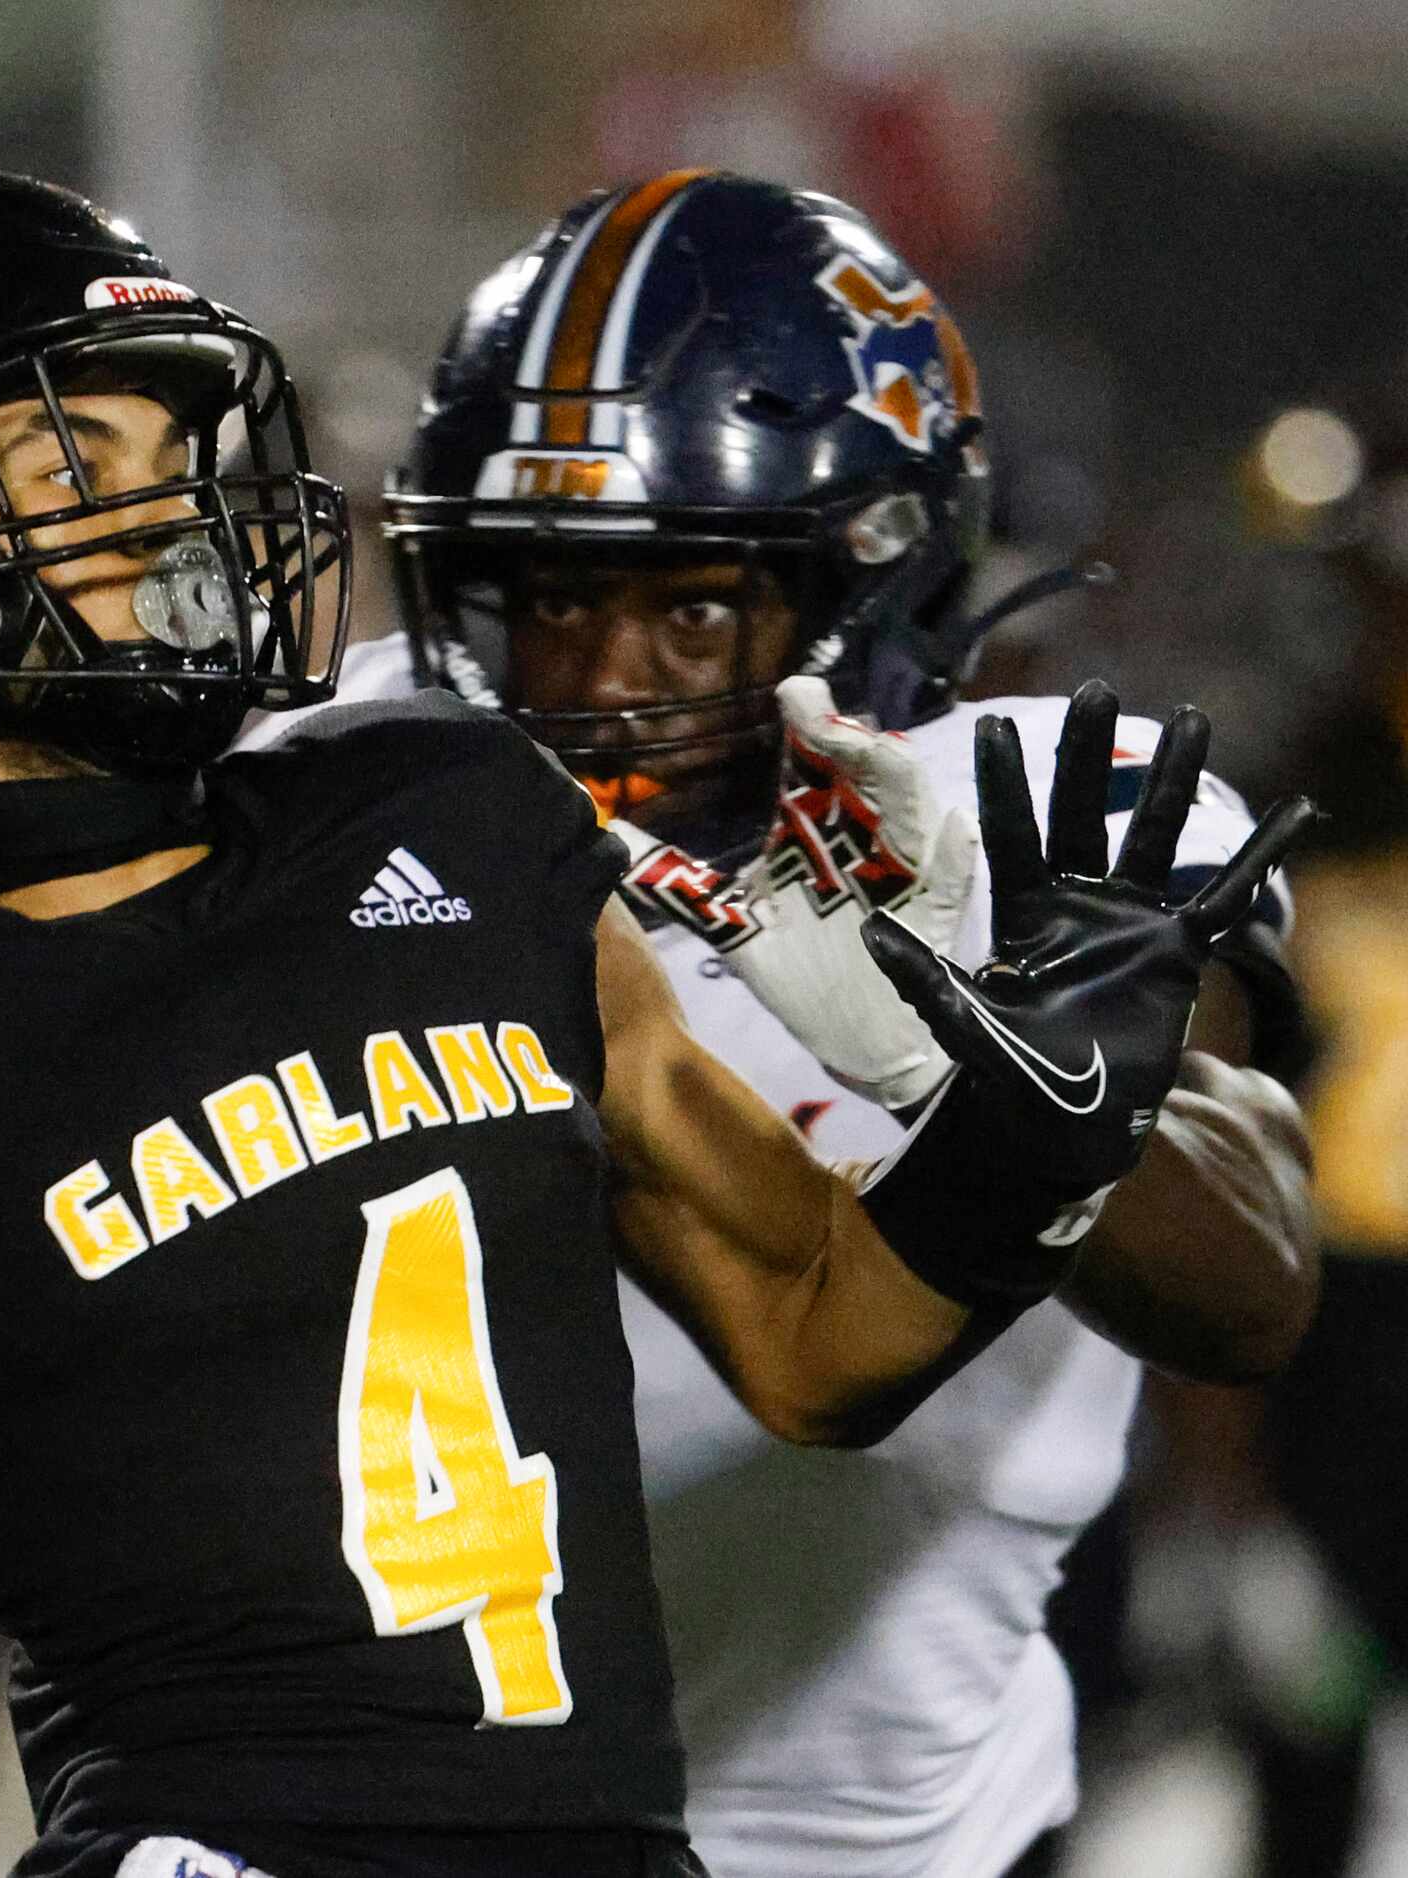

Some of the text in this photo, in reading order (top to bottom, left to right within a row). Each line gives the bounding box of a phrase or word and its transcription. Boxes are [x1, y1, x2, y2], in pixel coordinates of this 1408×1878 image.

[349, 896, 472, 928] adidas
[44, 1021, 574, 1281] GARLAND
[338, 1166, 573, 1727] 4
